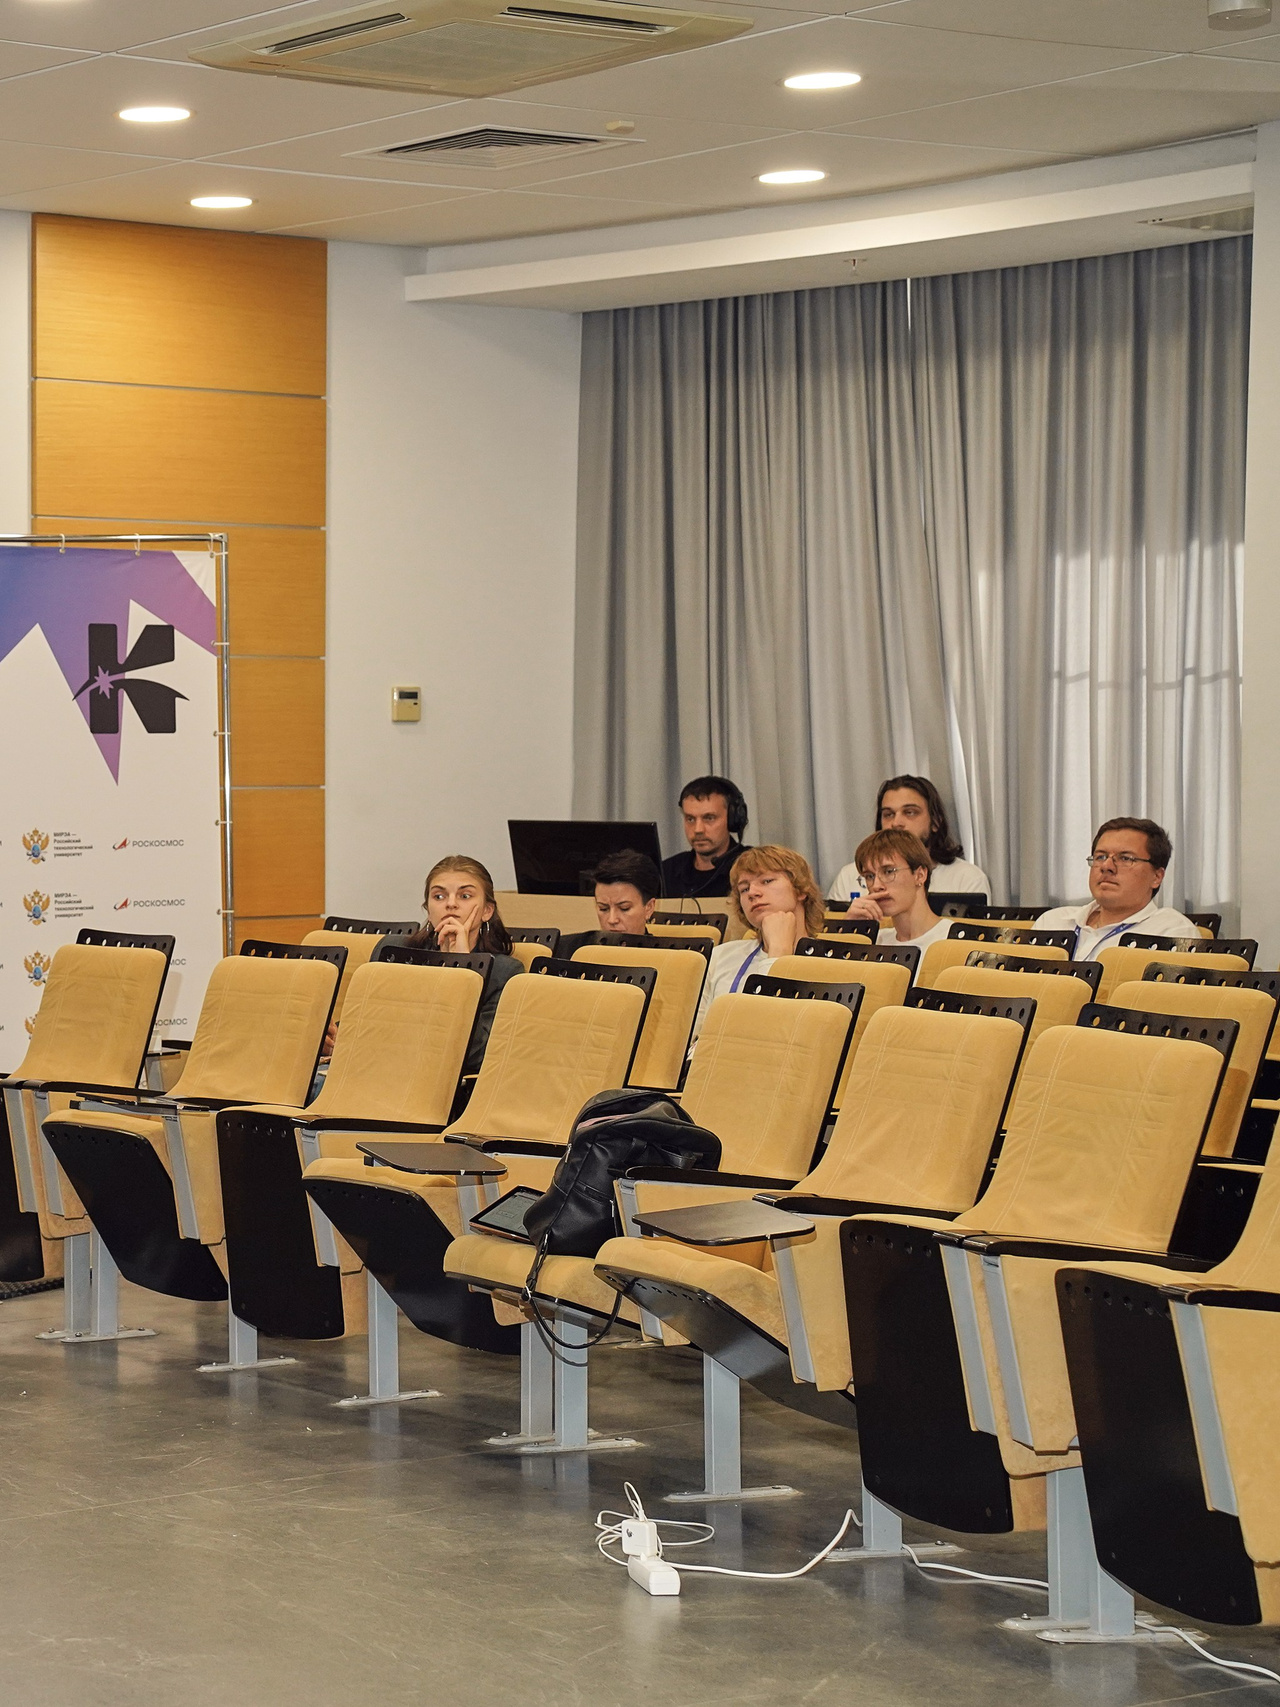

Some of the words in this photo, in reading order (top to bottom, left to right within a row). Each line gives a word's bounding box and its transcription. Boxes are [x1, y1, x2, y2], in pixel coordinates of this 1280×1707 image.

[132, 839, 185, 848] РОСКОСМОС
[133, 899, 186, 907] РОСКОСМОС
[156, 1018, 187, 1026] ОСМОС
